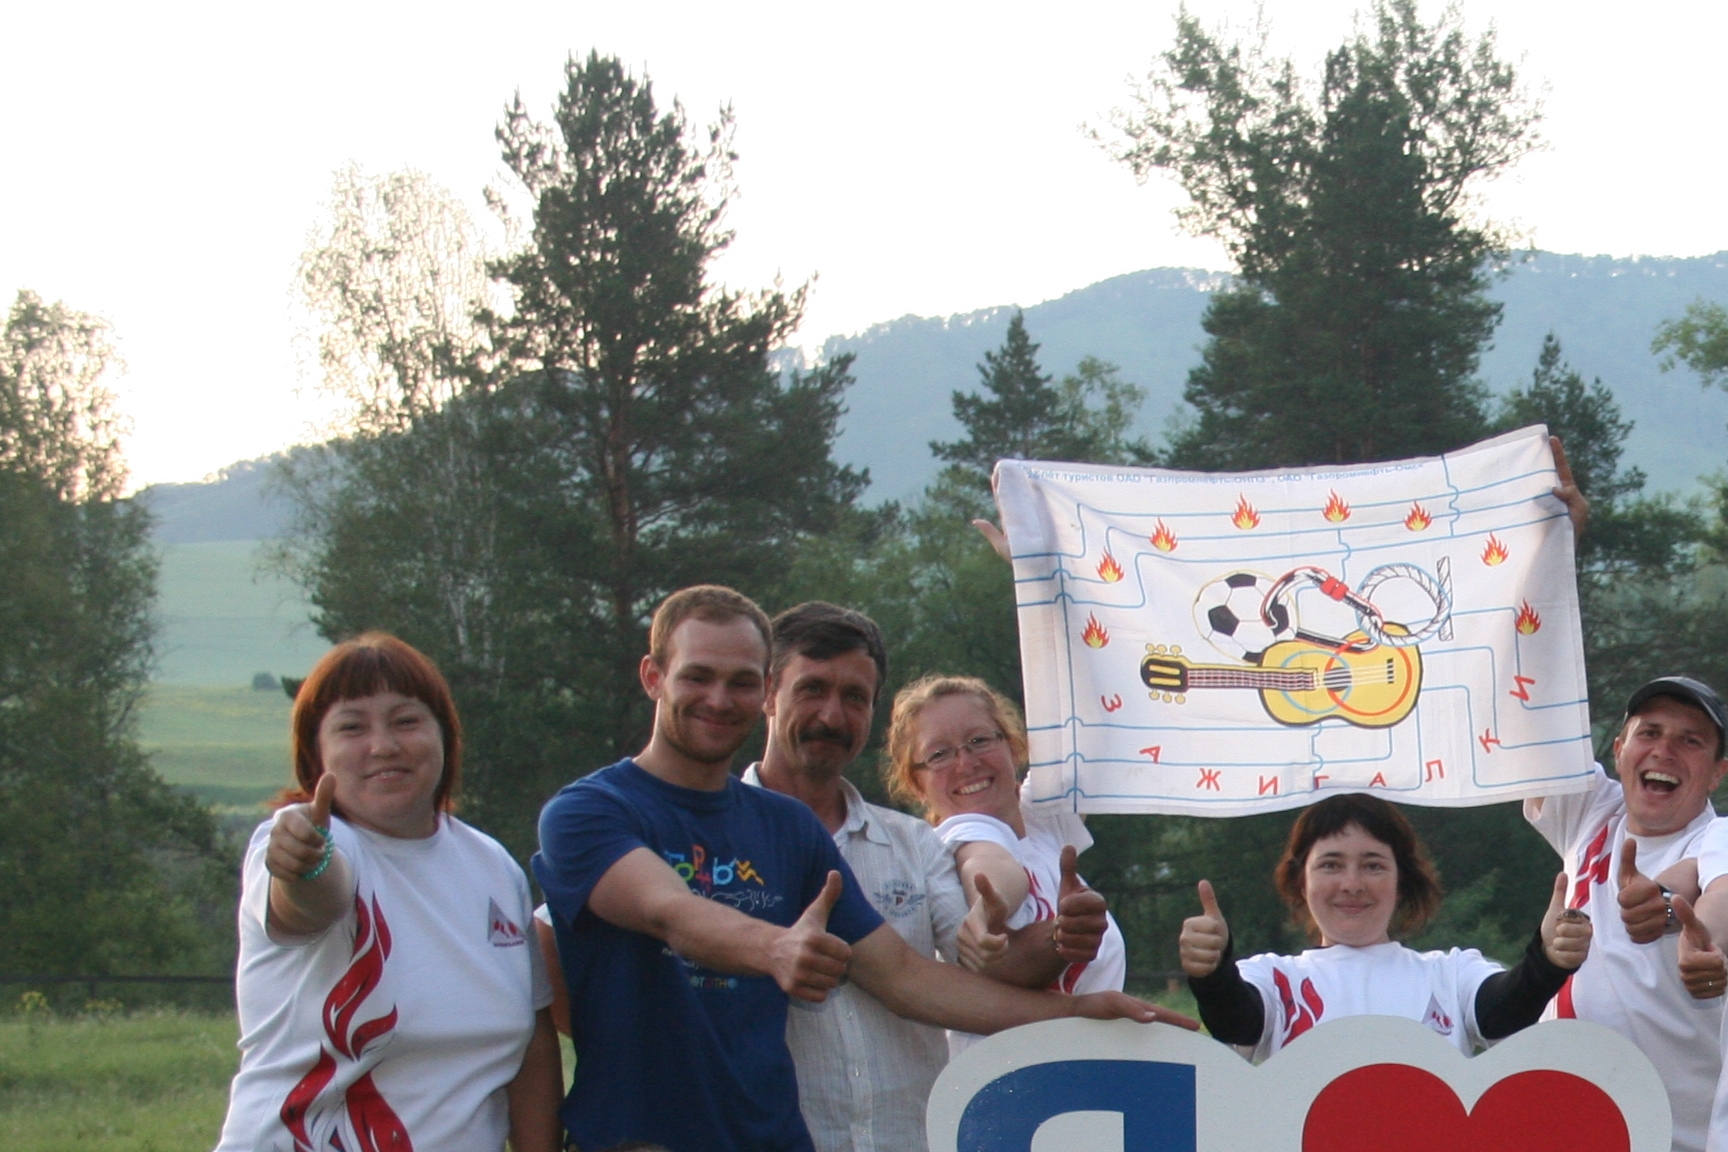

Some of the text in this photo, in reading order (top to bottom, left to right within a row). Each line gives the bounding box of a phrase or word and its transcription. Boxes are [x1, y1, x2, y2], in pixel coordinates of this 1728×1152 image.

[1063, 472, 1114, 484] туристов
[1116, 473, 1142, 483] ОАО
[1277, 474, 1302, 483] ОАО
